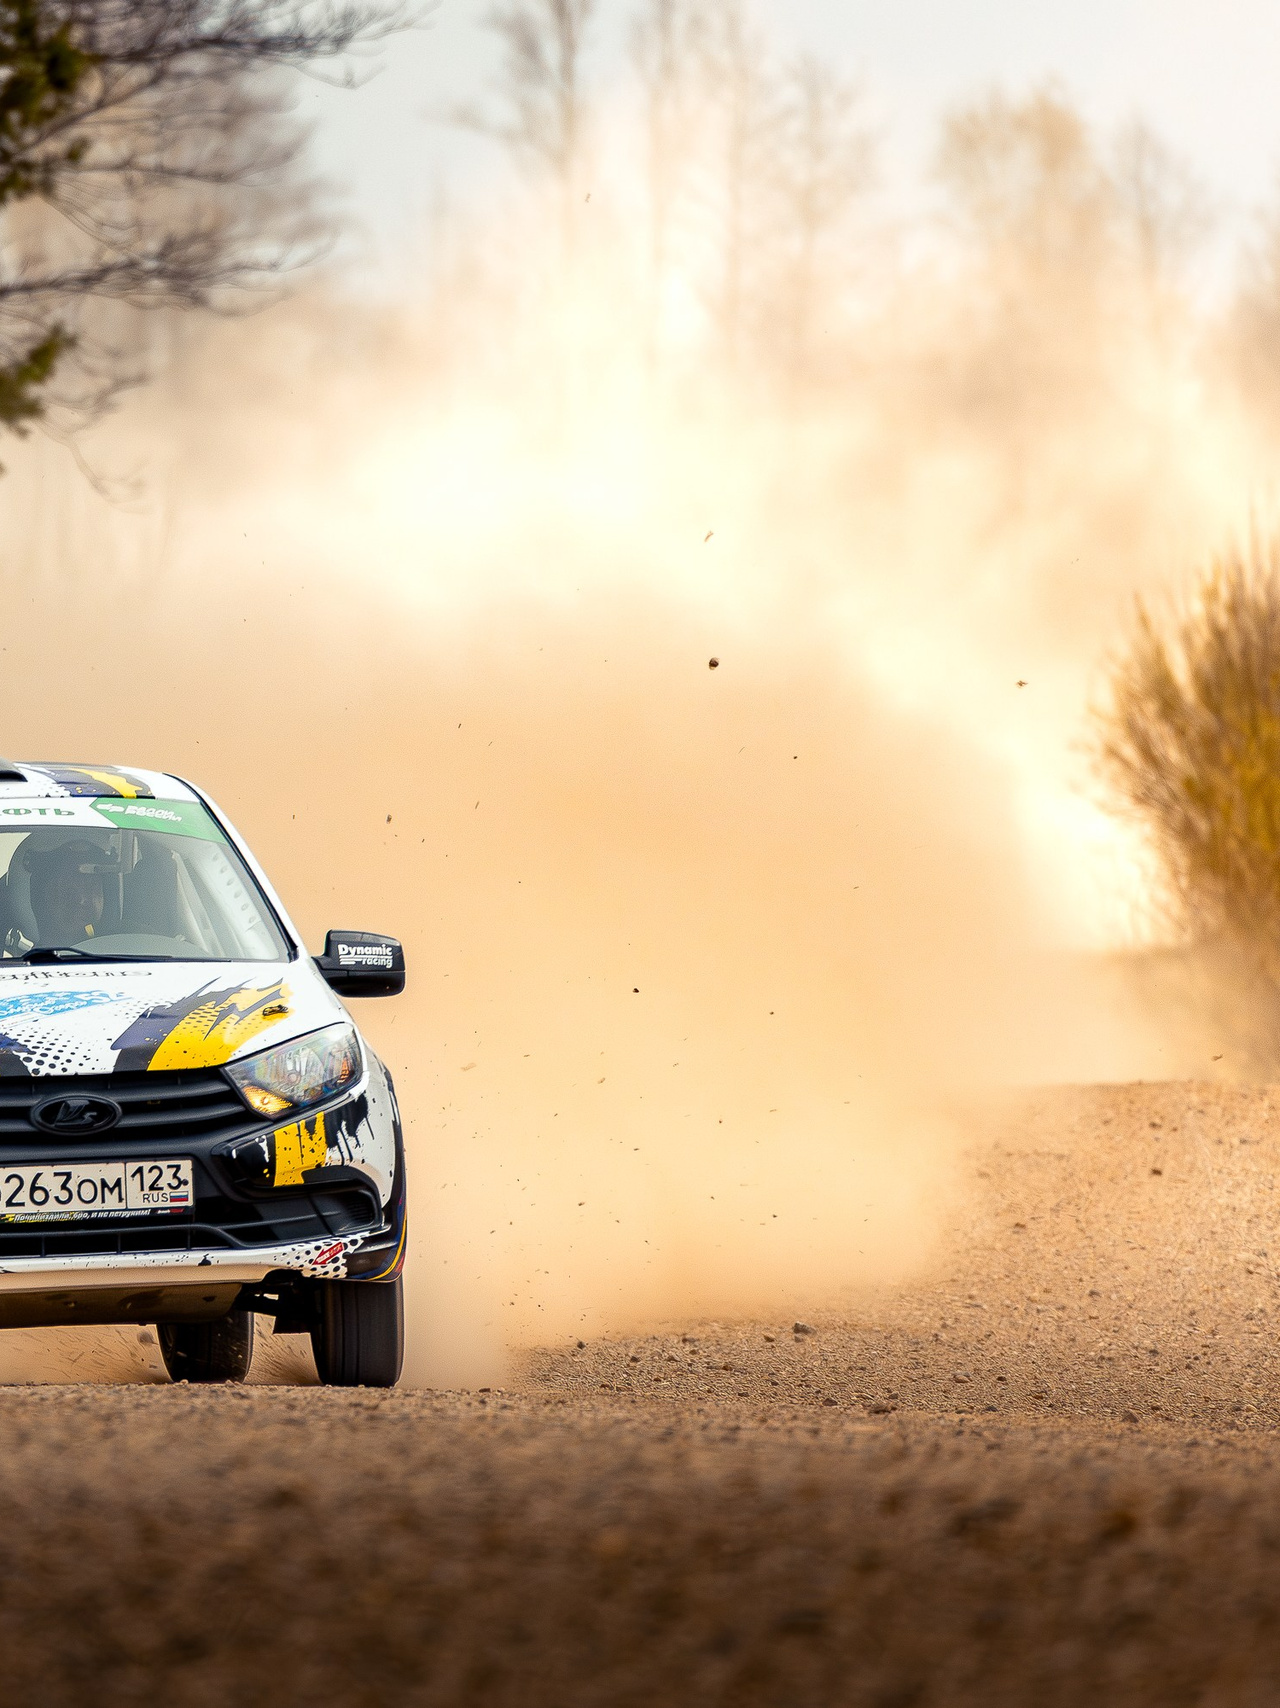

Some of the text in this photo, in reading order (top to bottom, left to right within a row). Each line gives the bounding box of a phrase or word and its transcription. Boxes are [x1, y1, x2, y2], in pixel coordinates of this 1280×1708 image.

[337, 944, 393, 957] Dynamic
[362, 957, 393, 968] racing
[130, 1164, 182, 1192] 123
[142, 1192, 169, 1204] RUS
